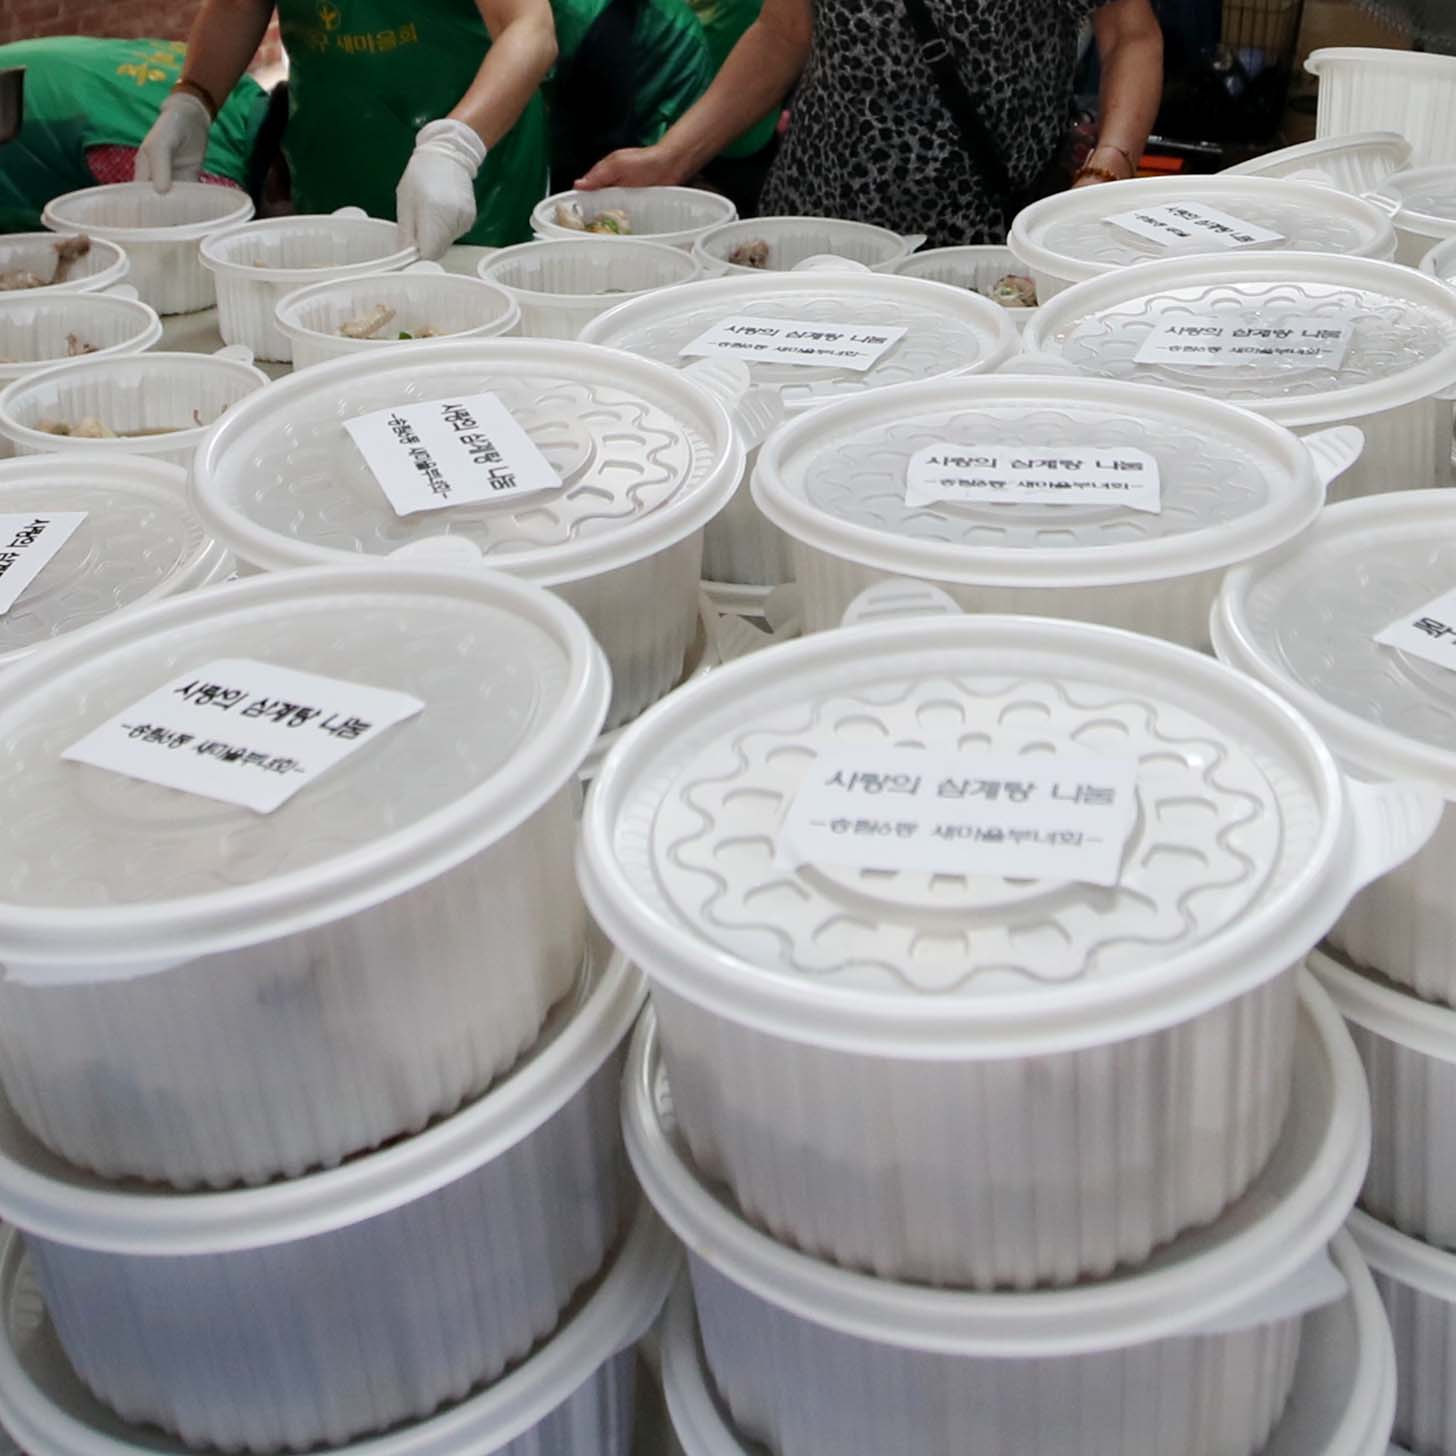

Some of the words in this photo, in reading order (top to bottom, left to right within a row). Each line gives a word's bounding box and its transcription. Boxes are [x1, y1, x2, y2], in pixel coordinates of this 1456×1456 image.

[6, 517, 51, 548] 사랑의
[174, 680, 249, 711] 사랑의
[241, 697, 322, 728] 삼계탕
[319, 713, 375, 741] 나눔
